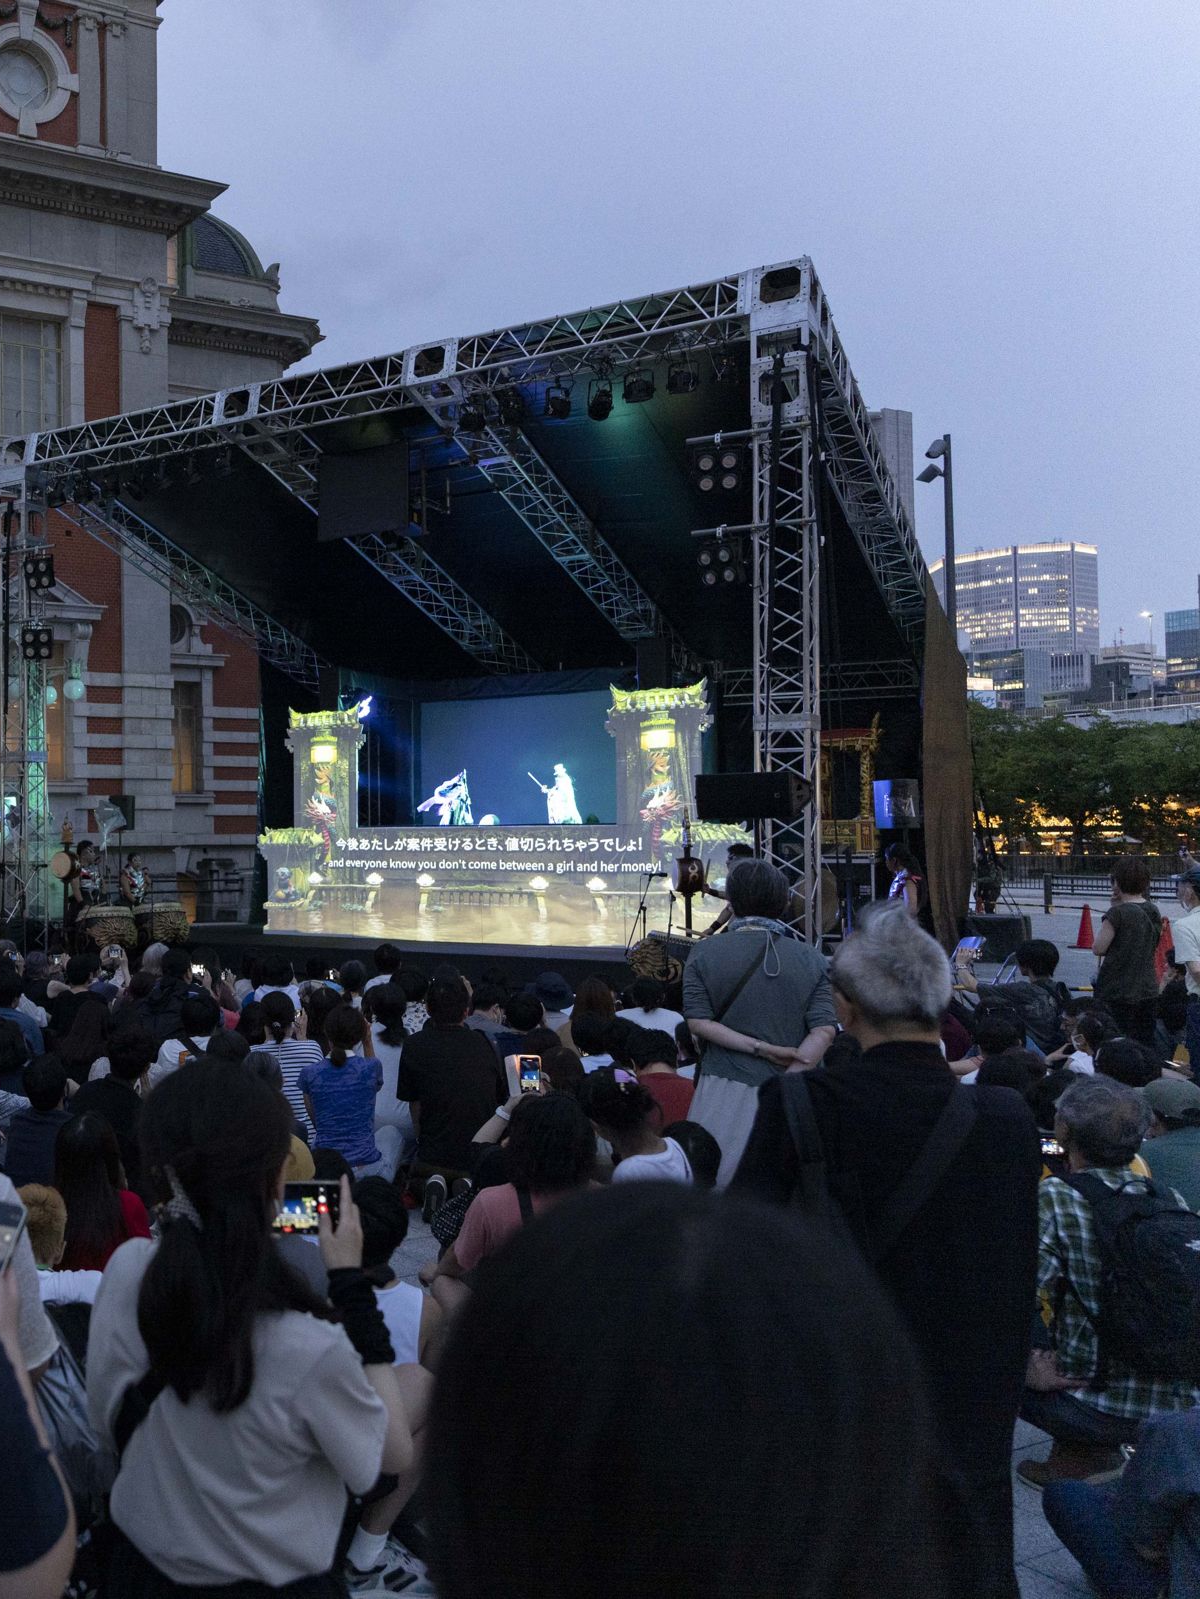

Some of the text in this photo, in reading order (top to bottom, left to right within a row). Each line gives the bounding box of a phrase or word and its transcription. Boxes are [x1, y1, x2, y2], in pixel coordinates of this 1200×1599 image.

[328, 858, 344, 868] and
[345, 859, 387, 870] everyone
[389, 858, 416, 869] know
[417, 861, 437, 871] you
[438, 859, 466, 870] don't
[468, 861, 497, 870] come
[499, 859, 545, 871] between
[547, 862, 554, 871] a
[556, 860, 574, 874] girl
[576, 861, 598, 872] and
[600, 861, 618, 872] her
[621, 862, 662, 874] money!
